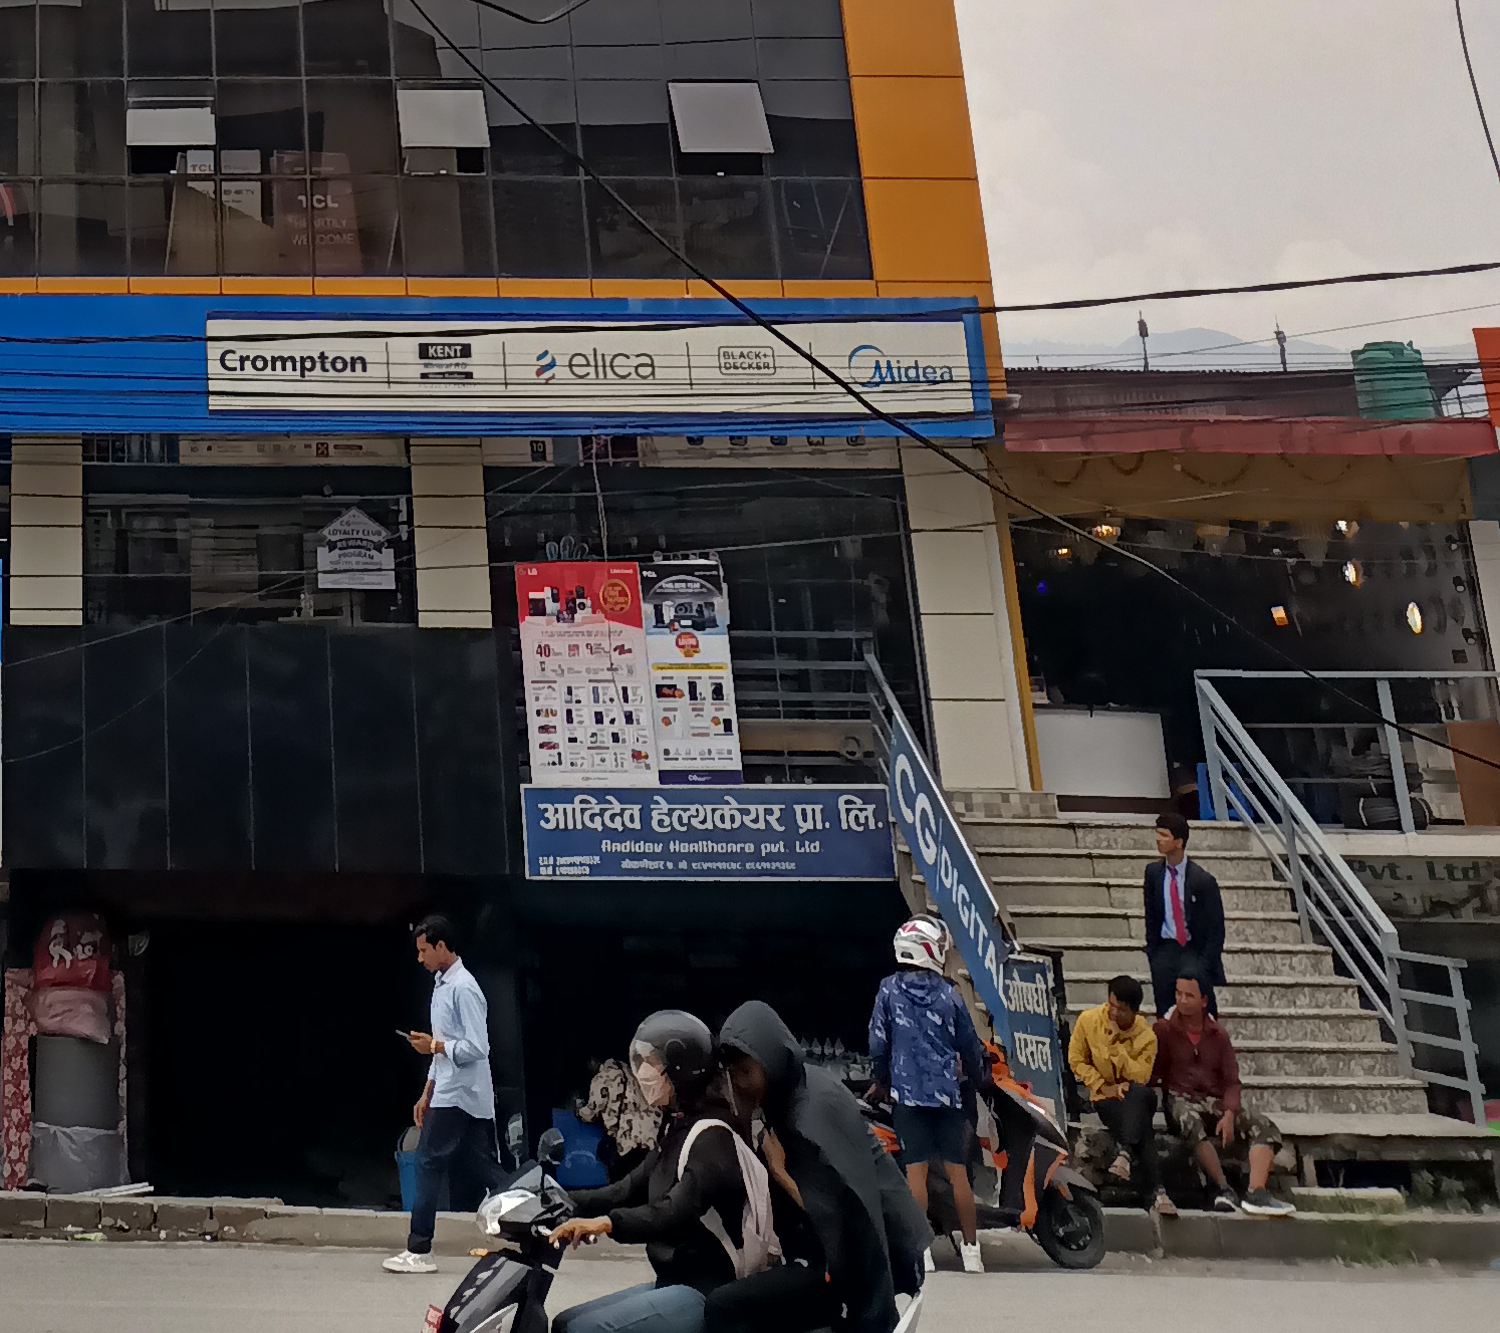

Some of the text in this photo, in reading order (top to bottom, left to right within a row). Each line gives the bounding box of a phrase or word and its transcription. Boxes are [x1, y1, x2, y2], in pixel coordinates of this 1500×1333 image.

[219, 349, 368, 379] Crompton
[428, 345, 463, 358] KENT
[568, 347, 656, 380] elica
[722, 350, 770, 361] BLACK+
[723, 361, 771, 371] DECKER
[864, 356, 954, 388] Midea
[538, 794, 884, 835] आदिदेव हेल्थकेयर प्रा. लि.
[894, 753, 1008, 1010] CG DIGITAL
